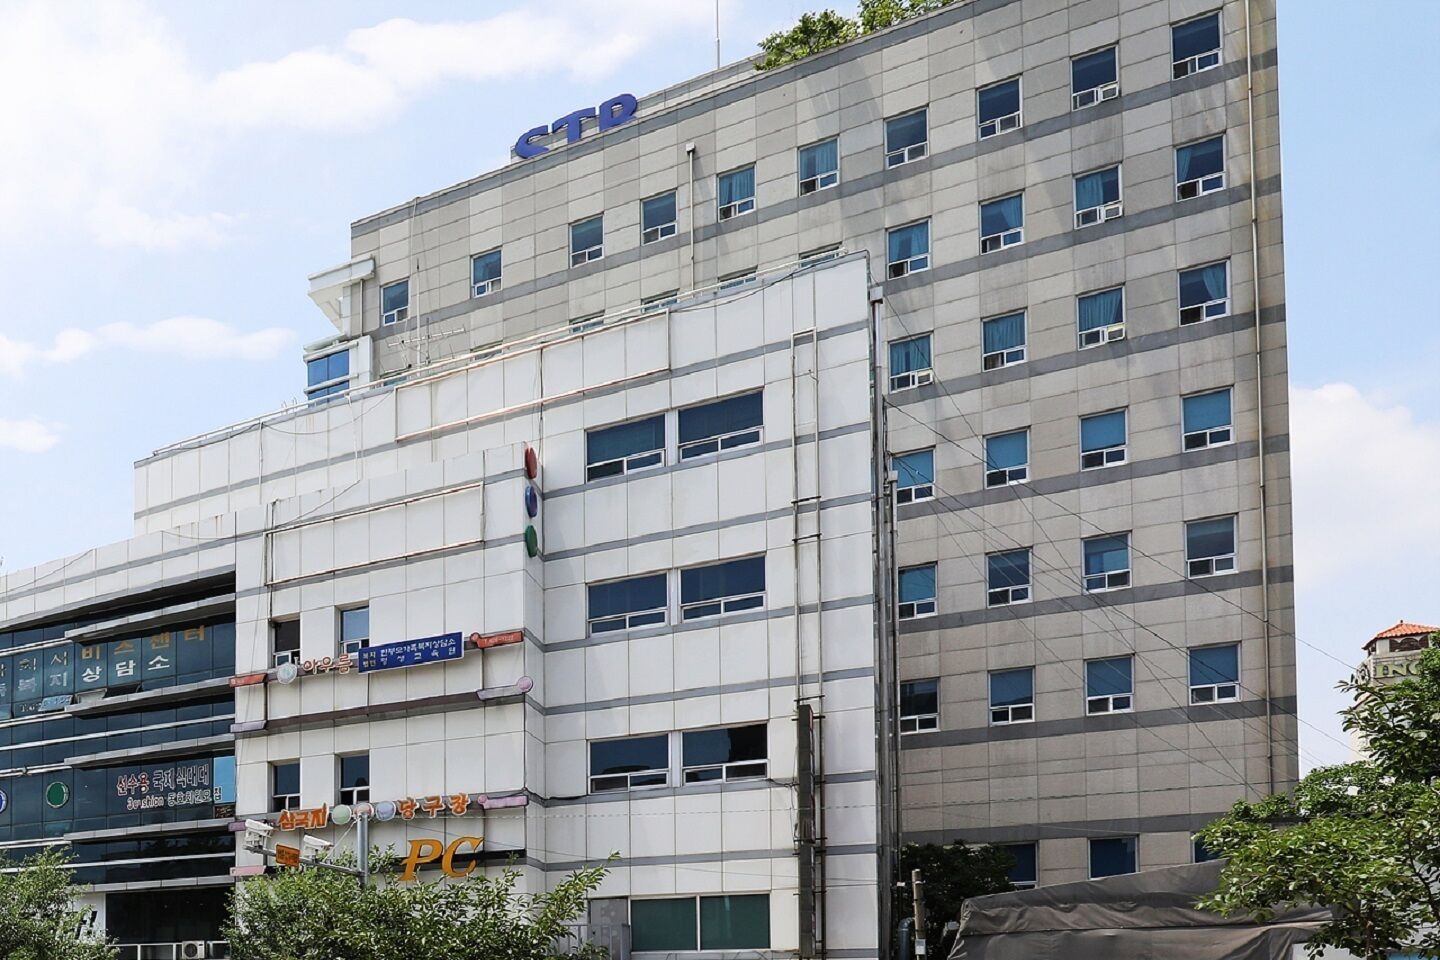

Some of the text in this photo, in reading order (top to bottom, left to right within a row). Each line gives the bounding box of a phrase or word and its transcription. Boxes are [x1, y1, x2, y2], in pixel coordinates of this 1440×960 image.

[303, 654, 353, 675] 아우름
[277, 793, 470, 831] 삼국지 당구장
[399, 836, 484, 882] PC
